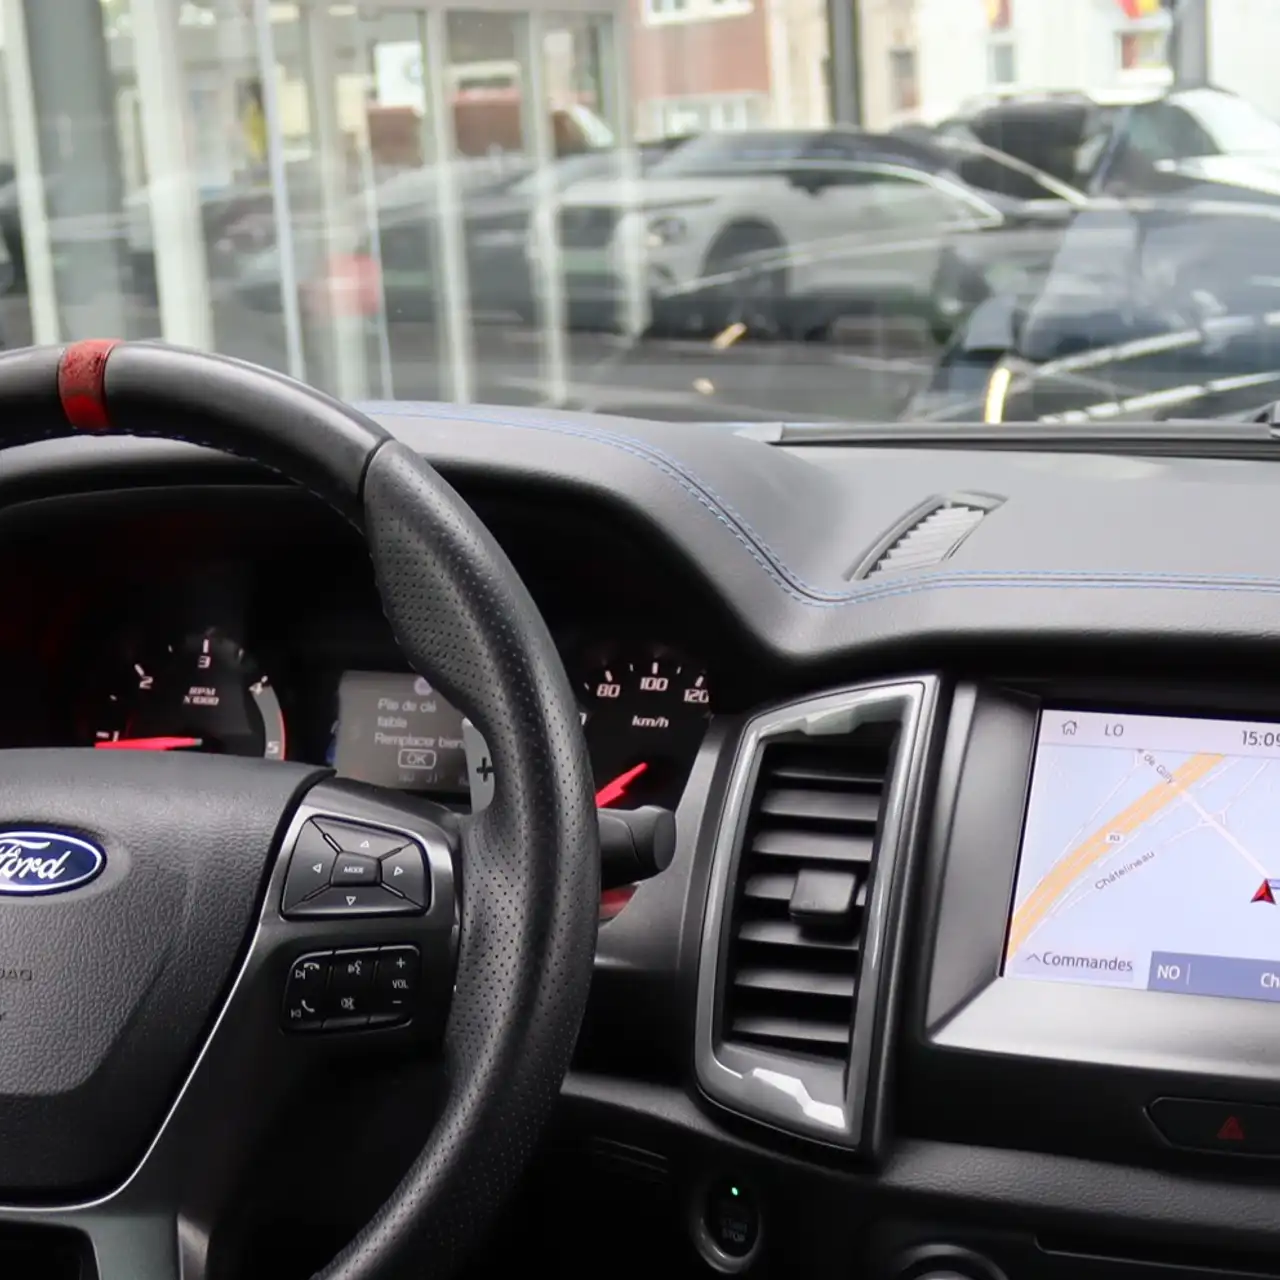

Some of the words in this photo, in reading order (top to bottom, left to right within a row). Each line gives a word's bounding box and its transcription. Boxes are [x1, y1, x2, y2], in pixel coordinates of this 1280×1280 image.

[198, 655, 211, 669] 3
[139, 676, 154, 690] 2
[248, 682, 264, 695] 4
[639, 676, 669, 692] 100
[188, 686, 216, 696] RPM
[596, 683, 621, 698] 80
[683, 688, 710, 703] 120
[631, 715, 670, 729] km/h
[1104, 723, 1124, 738] LO
[266, 740, 280, 755] 5
[406, 752, 428, 766] OK
[343, 865, 365, 875] MODE
[1095, 850, 1155, 891] Châtelineau
[1042, 951, 1134, 972] Commandes
[1156, 964, 1181, 980] NO
[392, 978, 409, 989] VOL
